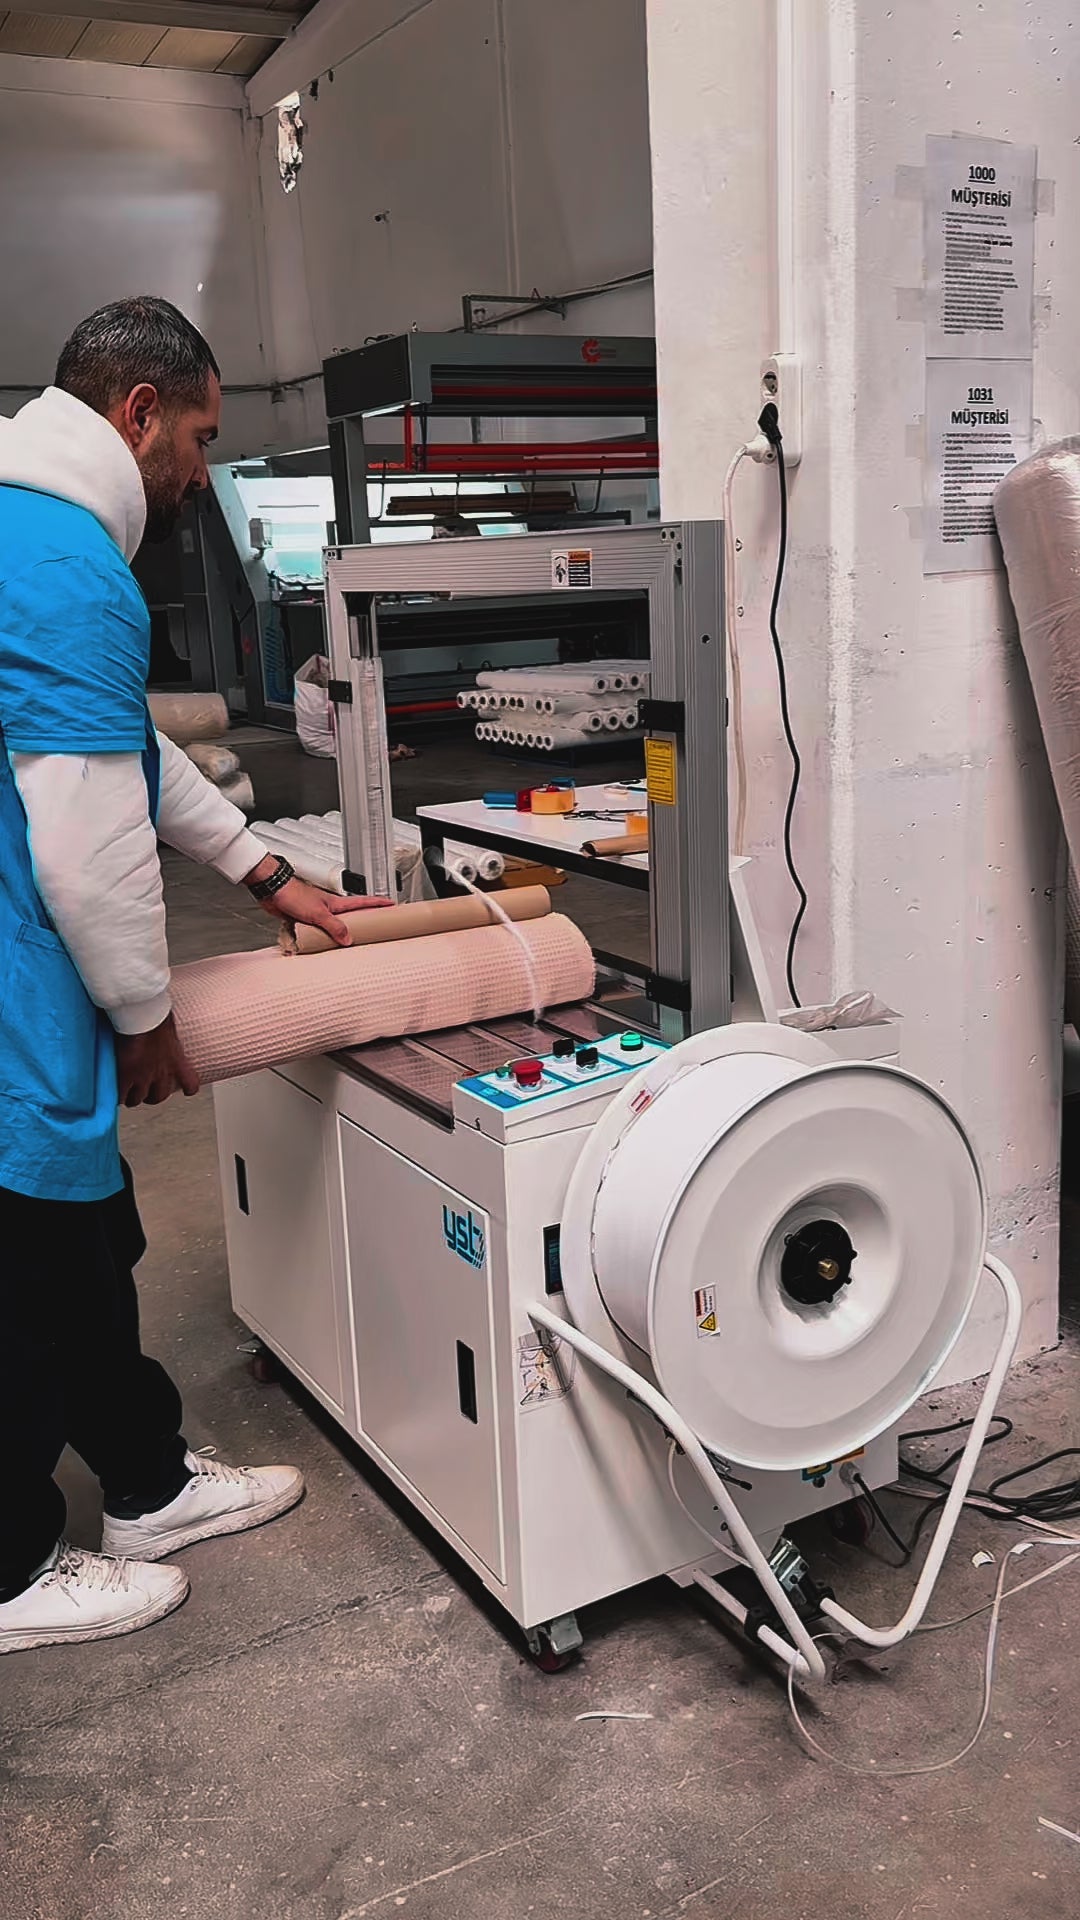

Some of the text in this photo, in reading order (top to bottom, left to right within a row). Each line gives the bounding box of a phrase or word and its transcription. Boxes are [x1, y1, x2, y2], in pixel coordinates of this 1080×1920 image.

[968, 165, 996, 182] 1000
[951, 187, 1012, 208] MÜŞTERİSİ
[967, 387, 994, 401] 1031
[951, 408, 1009, 427] MÜŞTERİSİ
